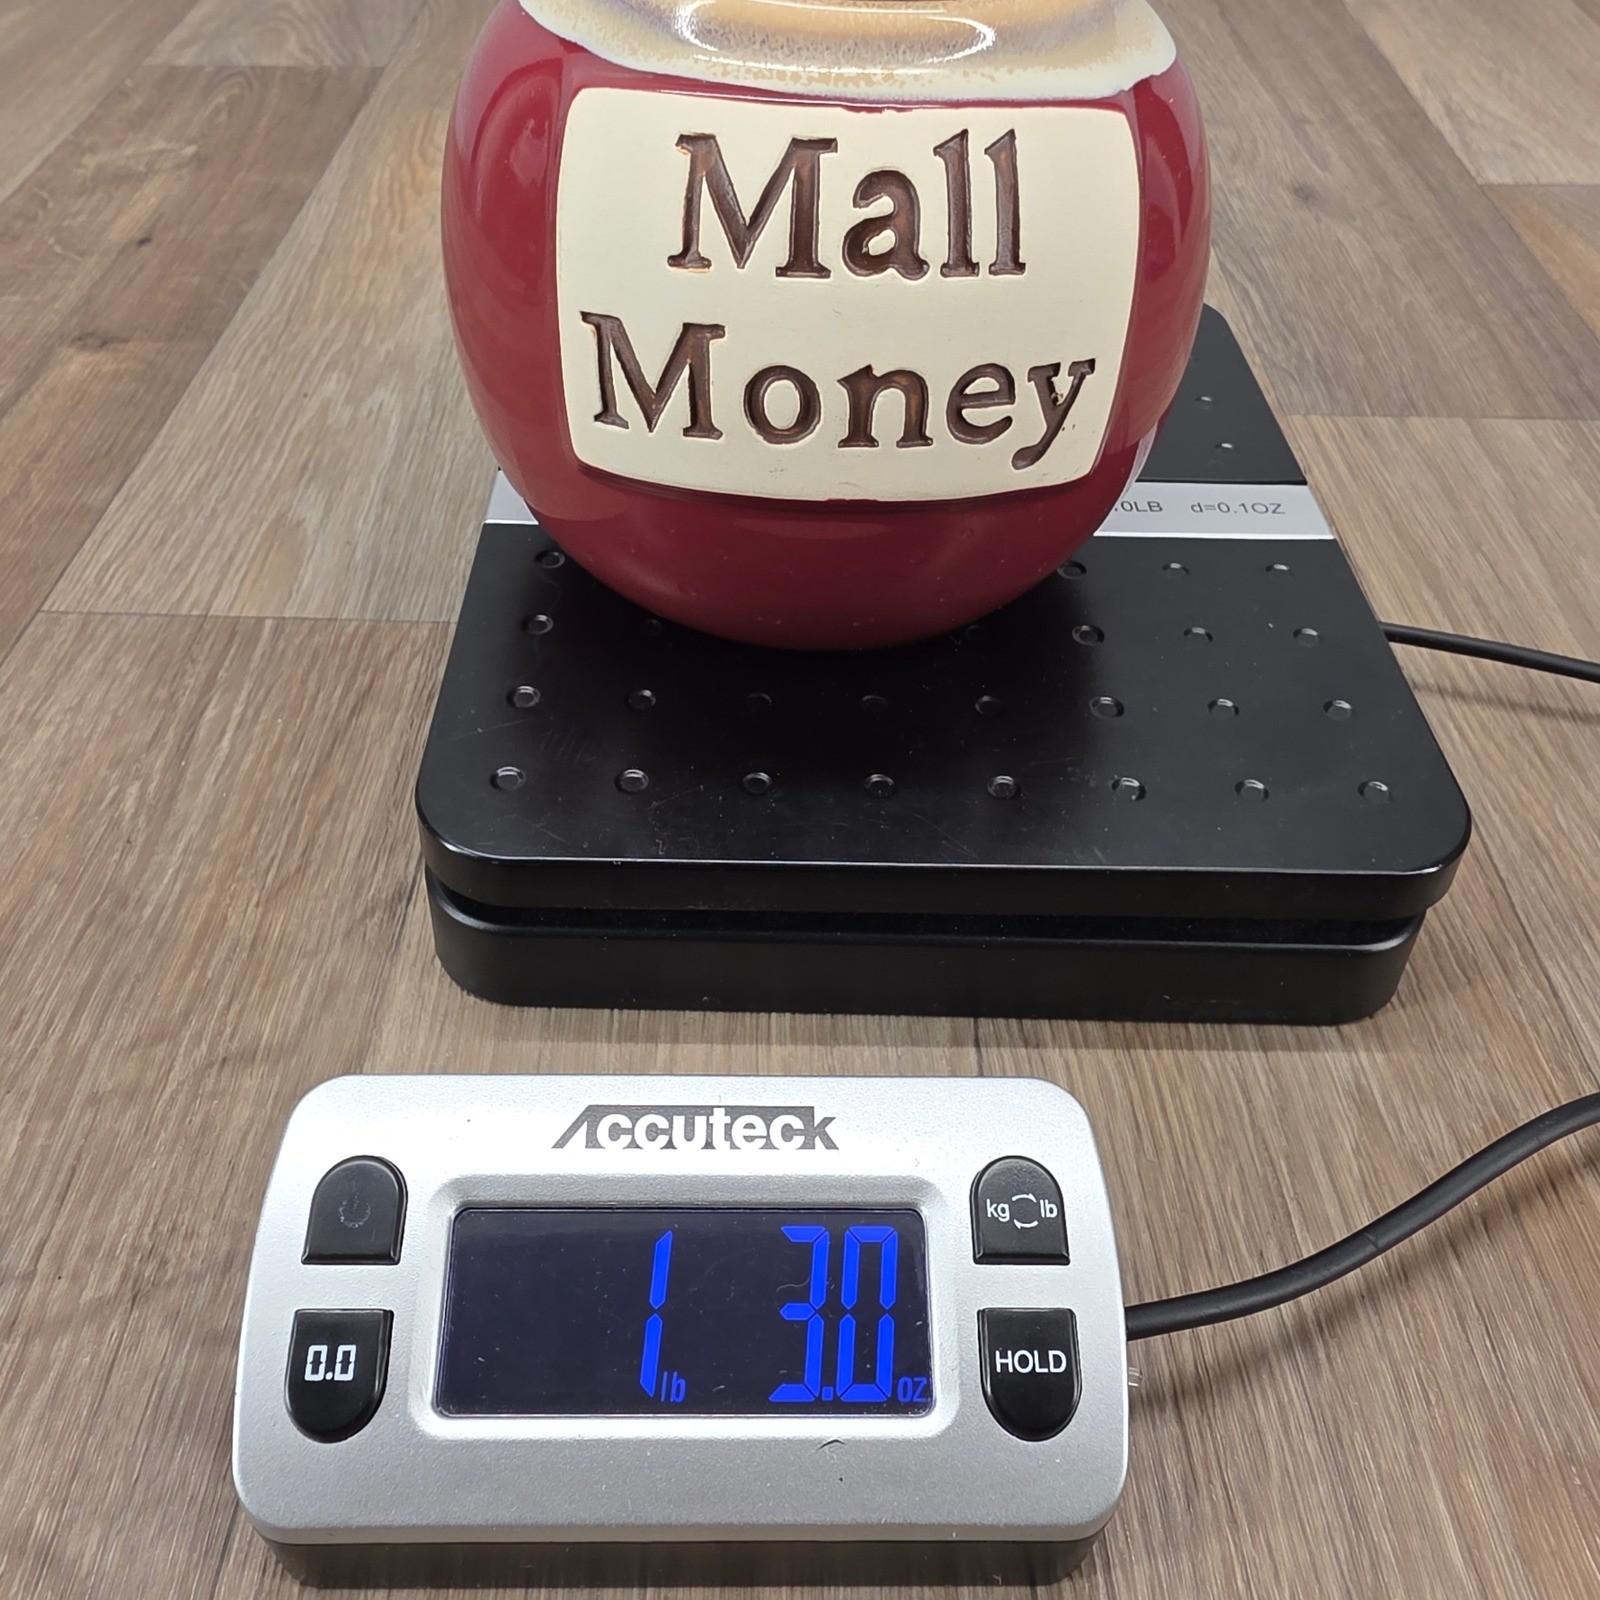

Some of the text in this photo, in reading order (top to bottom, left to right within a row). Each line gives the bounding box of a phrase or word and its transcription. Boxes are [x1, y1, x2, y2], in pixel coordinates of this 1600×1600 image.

[667, 129, 1027, 281] Mall
[579, 311, 1096, 470] Money
[551, 1105, 840, 1150] Accuteck
[986, 1199, 1059, 1222] kg lb
[769, 1226, 898, 1402] 3.0
[305, 1344, 357, 1382] 0.0
[995, 1351, 1067, 1374] HOLD
